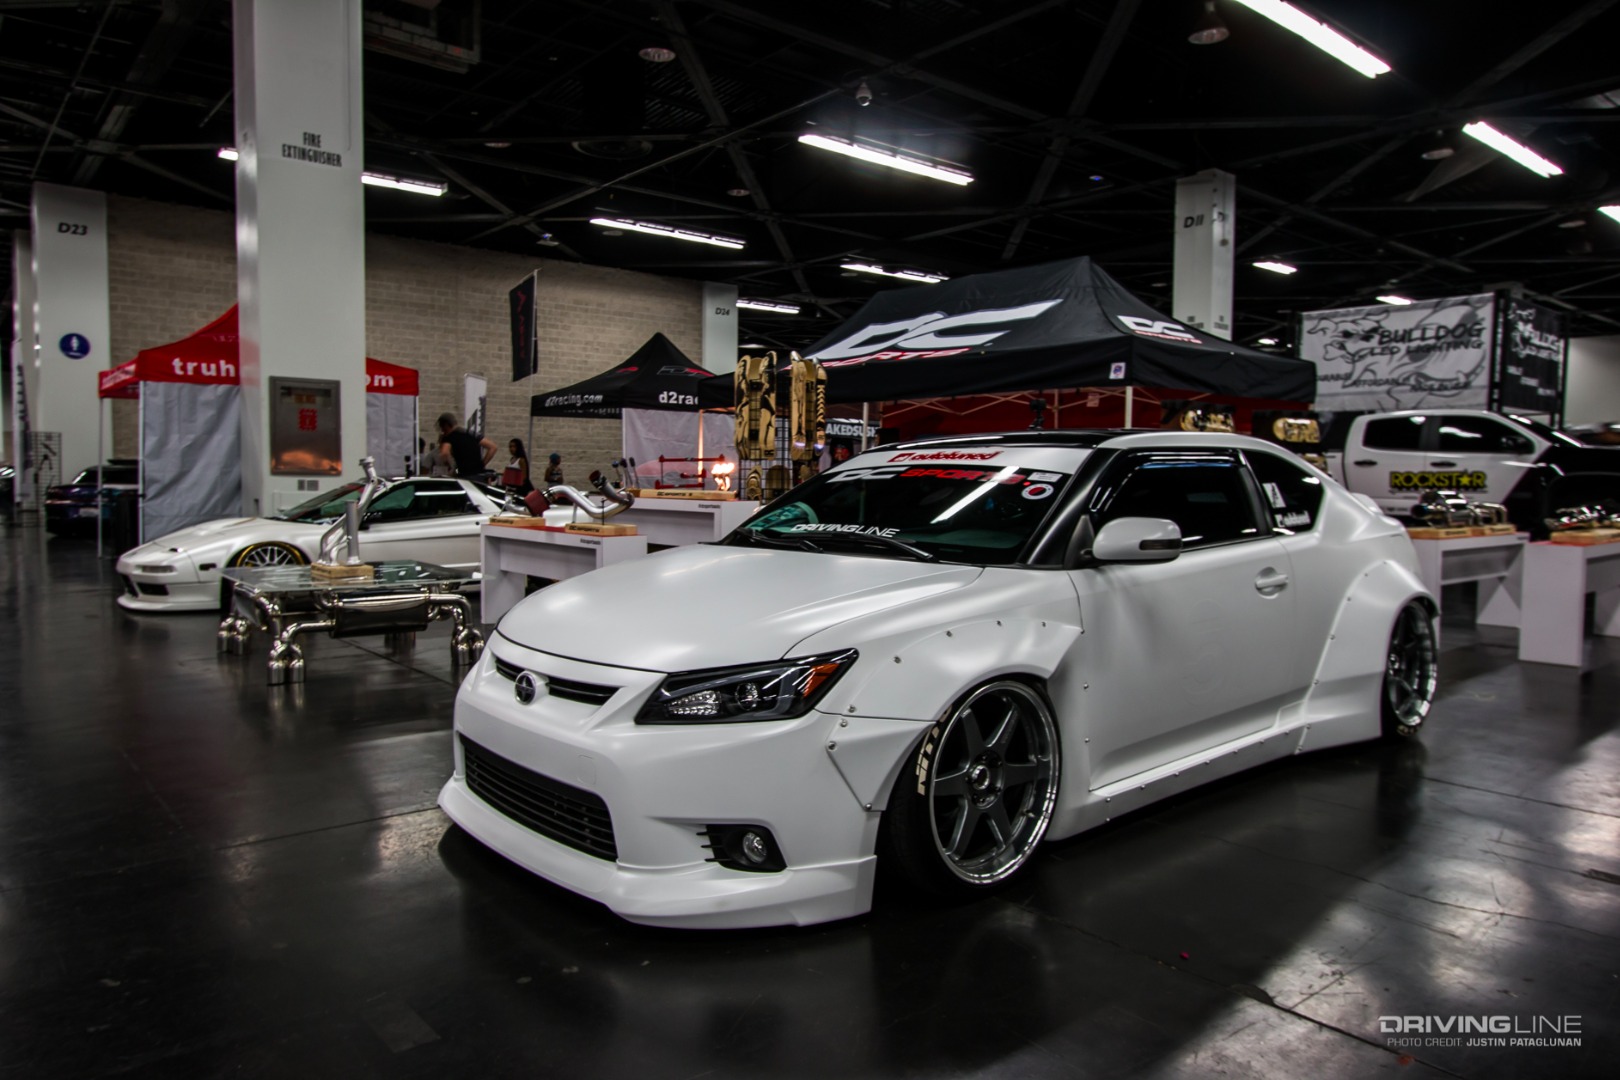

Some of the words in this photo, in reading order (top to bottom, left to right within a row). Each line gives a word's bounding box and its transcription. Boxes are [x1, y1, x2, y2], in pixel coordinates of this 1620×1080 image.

[303, 132, 322, 148] FIRE
[281, 144, 342, 167] EXTINGUISHER
[57, 222, 88, 236] D23
[715, 306, 730, 316] D24
[1378, 321, 1487, 346] BULLDOG
[544, 393, 604, 408] d2racing.com
